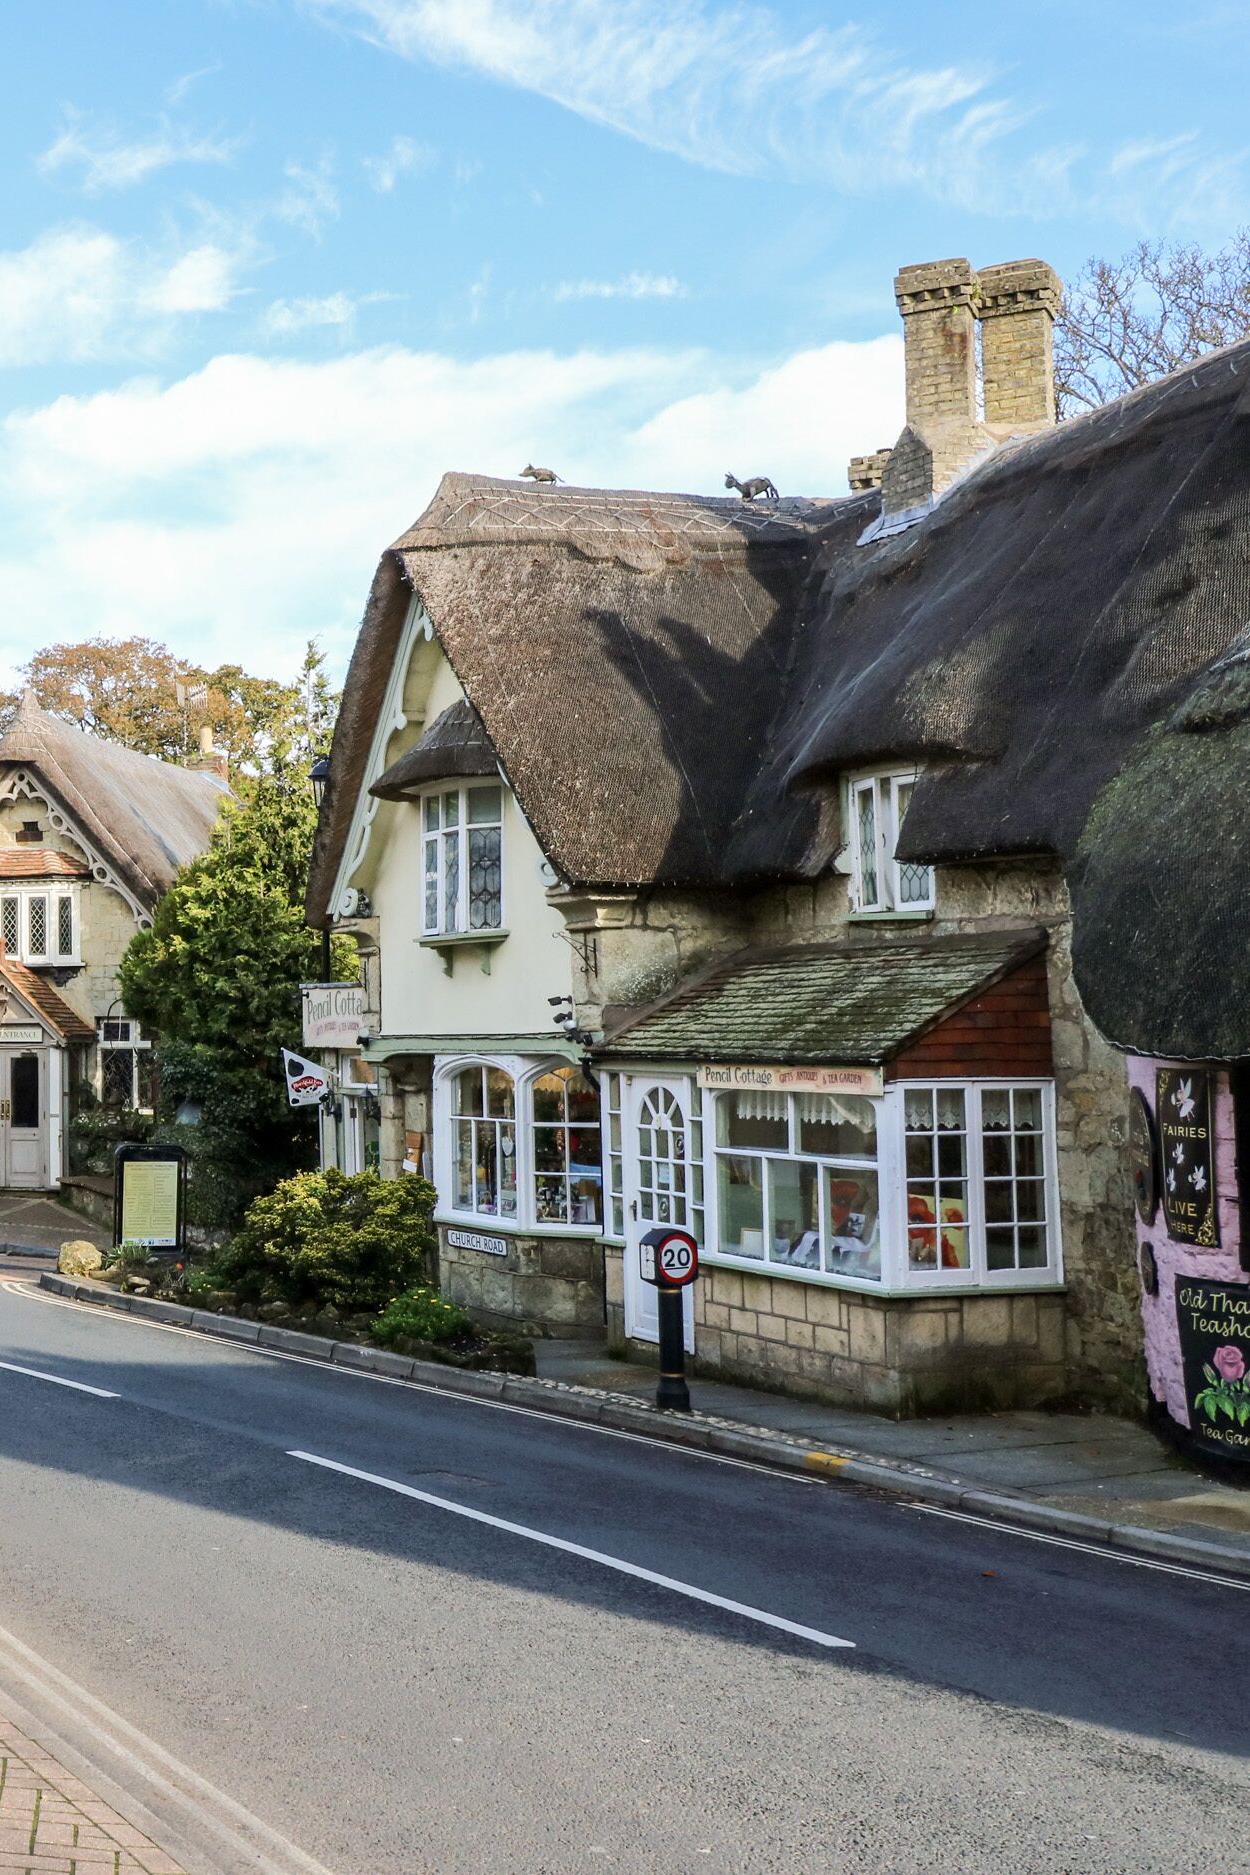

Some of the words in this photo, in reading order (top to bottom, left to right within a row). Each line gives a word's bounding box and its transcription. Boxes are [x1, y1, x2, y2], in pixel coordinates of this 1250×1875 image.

[307, 992, 332, 1024] Pencil
[0, 1031, 37, 1039] ENTRANCE
[705, 1066, 732, 1082] Pencil
[734, 1066, 773, 1086] Cottage
[779, 1072, 794, 1083] GIFTS
[827, 1074, 838, 1084] TEA
[838, 1073, 862, 1085] GARDEN
[1162, 1122, 1207, 1139] FAIRIES
[1168, 1197, 1198, 1217] LIVE
[1171, 1221, 1195, 1236] HERE
[450, 1231, 482, 1249] CHURCH
[483, 1238, 504, 1253] ROAD
[664, 1247, 690, 1267] 20
[1180, 1287, 1208, 1309] Old
[1200, 1422, 1224, 1440] Tea
